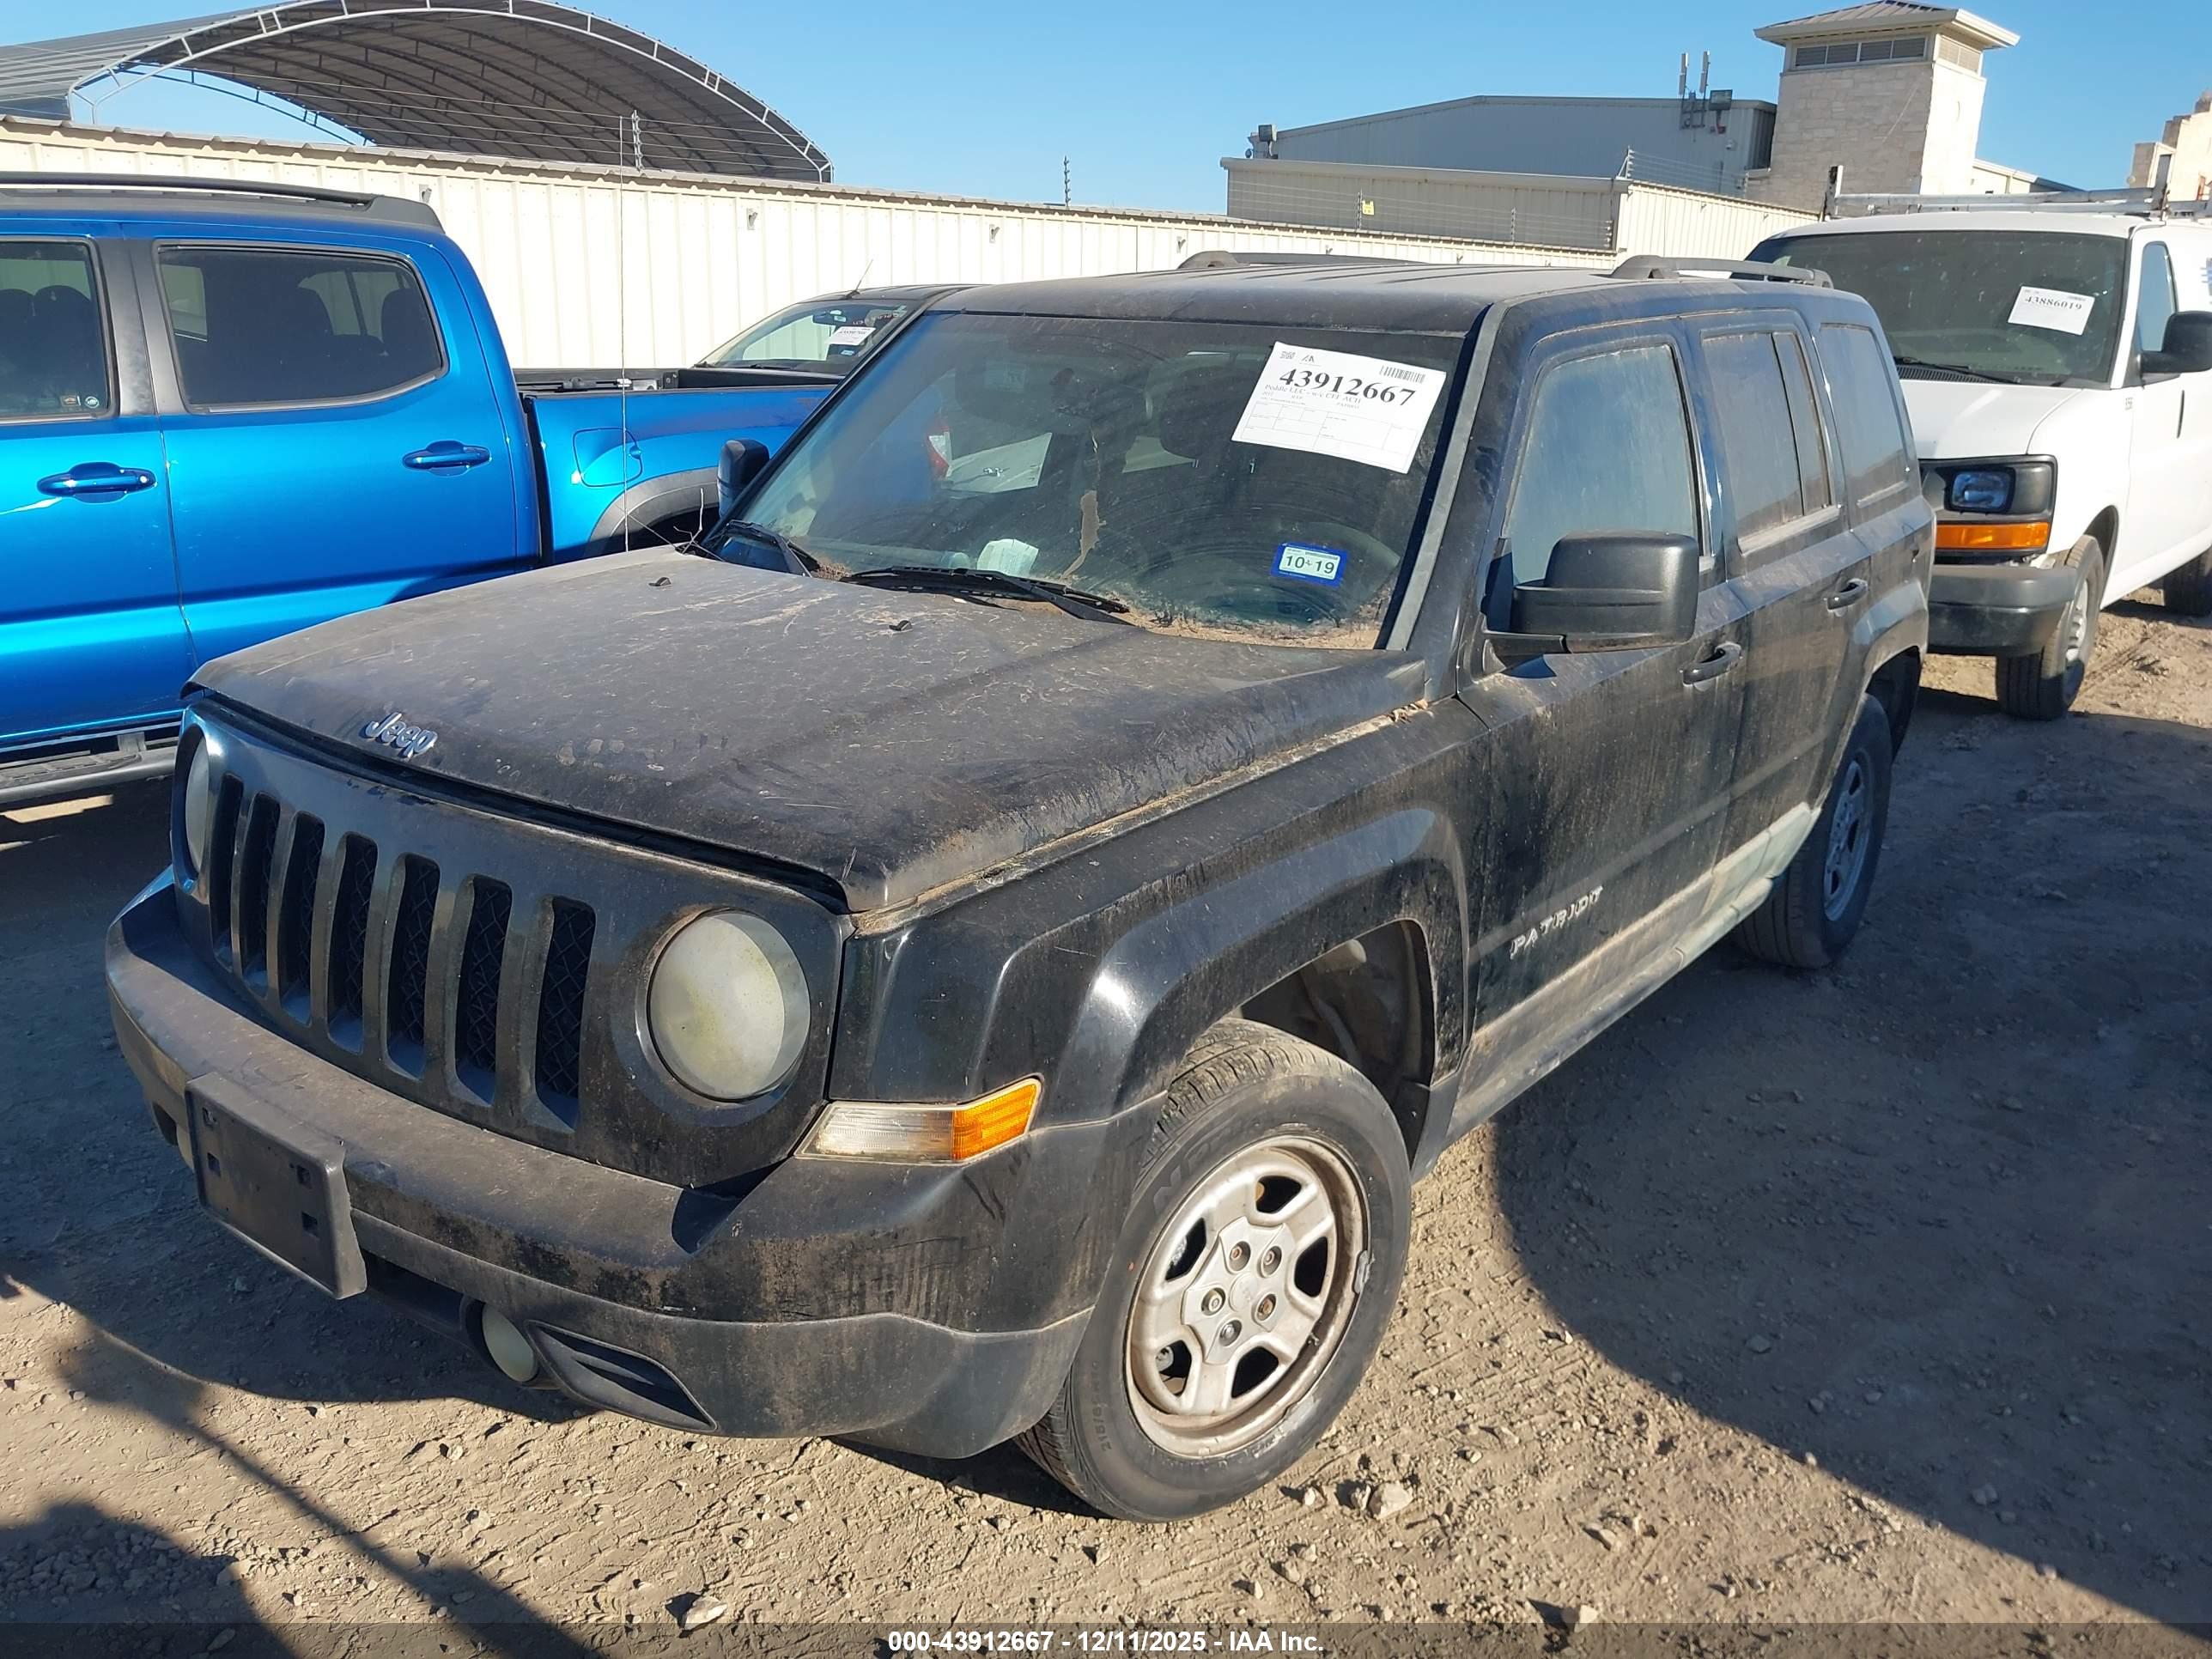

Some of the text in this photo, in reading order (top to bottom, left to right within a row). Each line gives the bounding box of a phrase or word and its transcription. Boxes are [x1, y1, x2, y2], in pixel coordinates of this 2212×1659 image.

[2025, 295, 2082, 310] 43886019
[1279, 368, 1416, 406] 43912667
[1286, 555, 1334, 574] 10 19
[365, 712, 438, 758] Jeep
[1510, 885, 1603, 960] PATRIOT
